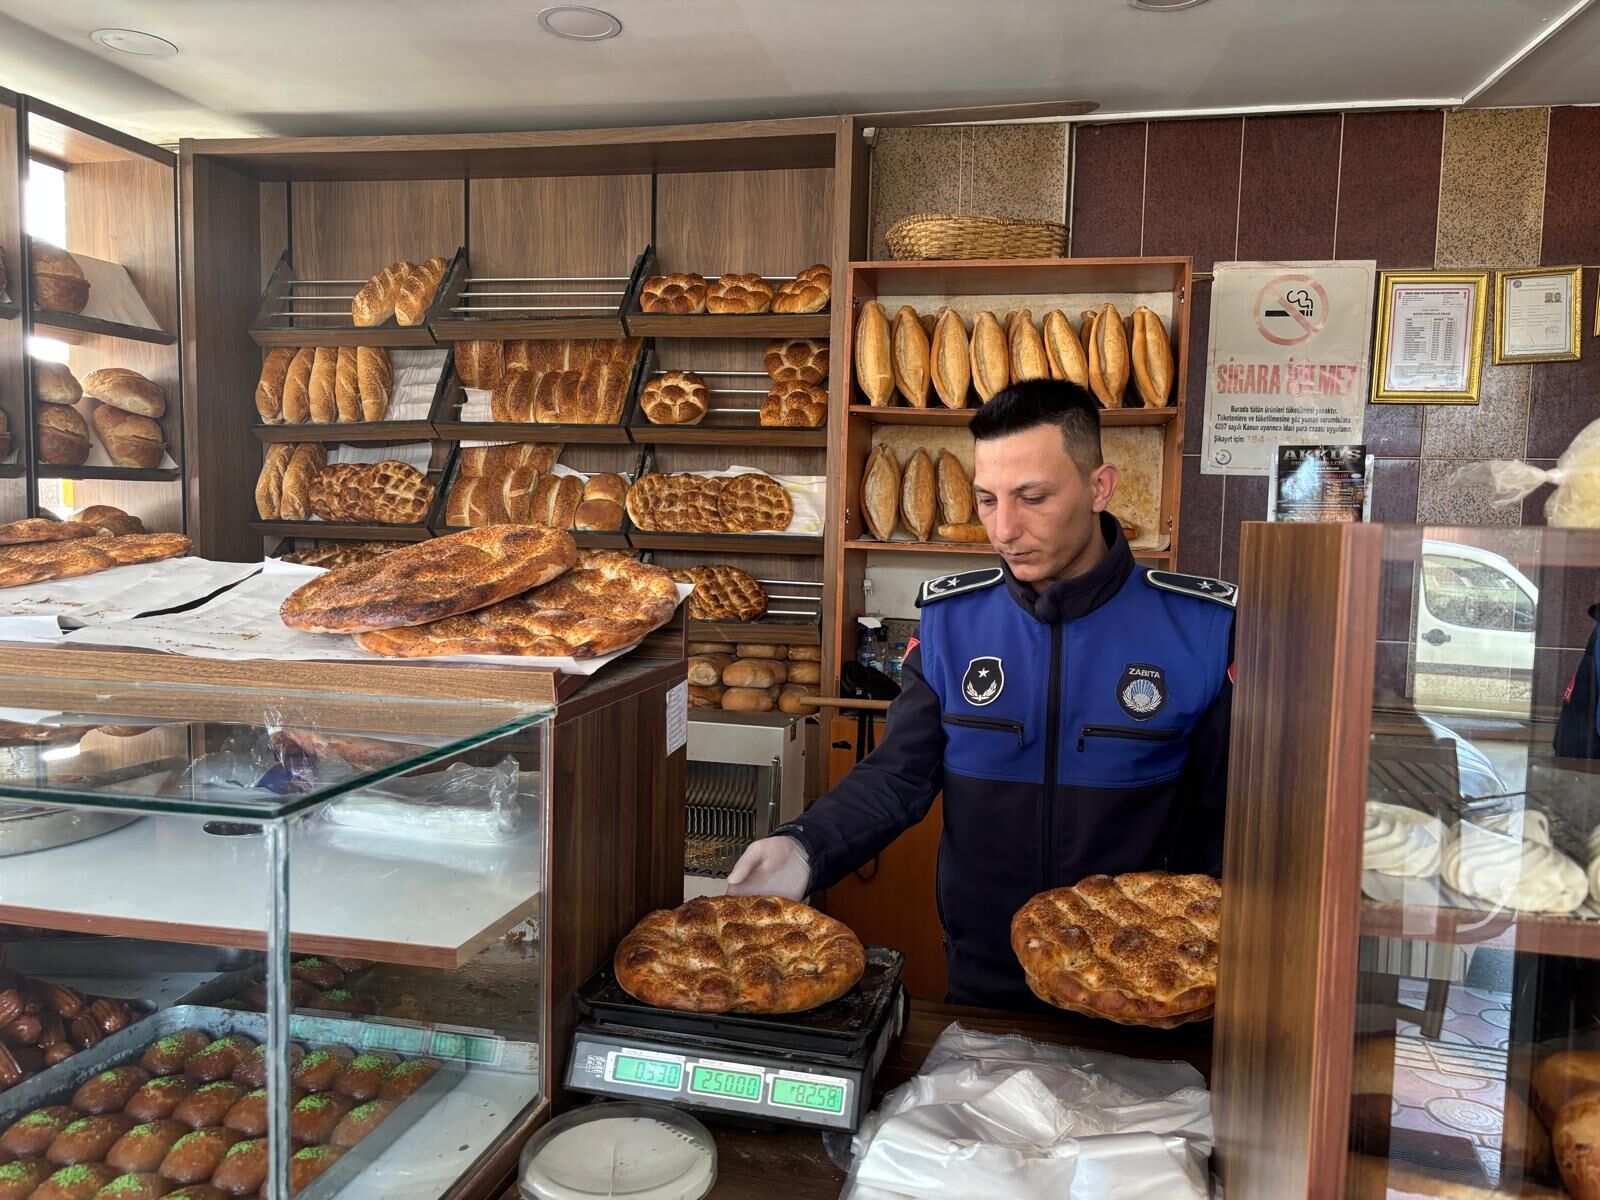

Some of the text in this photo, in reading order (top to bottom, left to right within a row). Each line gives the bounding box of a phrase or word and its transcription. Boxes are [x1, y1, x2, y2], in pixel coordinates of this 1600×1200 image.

[1216, 357, 1280, 394] SİGARA
[1256, 415, 1290, 423] tüketilmesine
[1228, 424, 1241, 432] sayılı
[1214, 435, 1232, 444] Şikayet
[1247, 435, 1265, 443] 184
[1129, 668, 1160, 679] ZABITA
